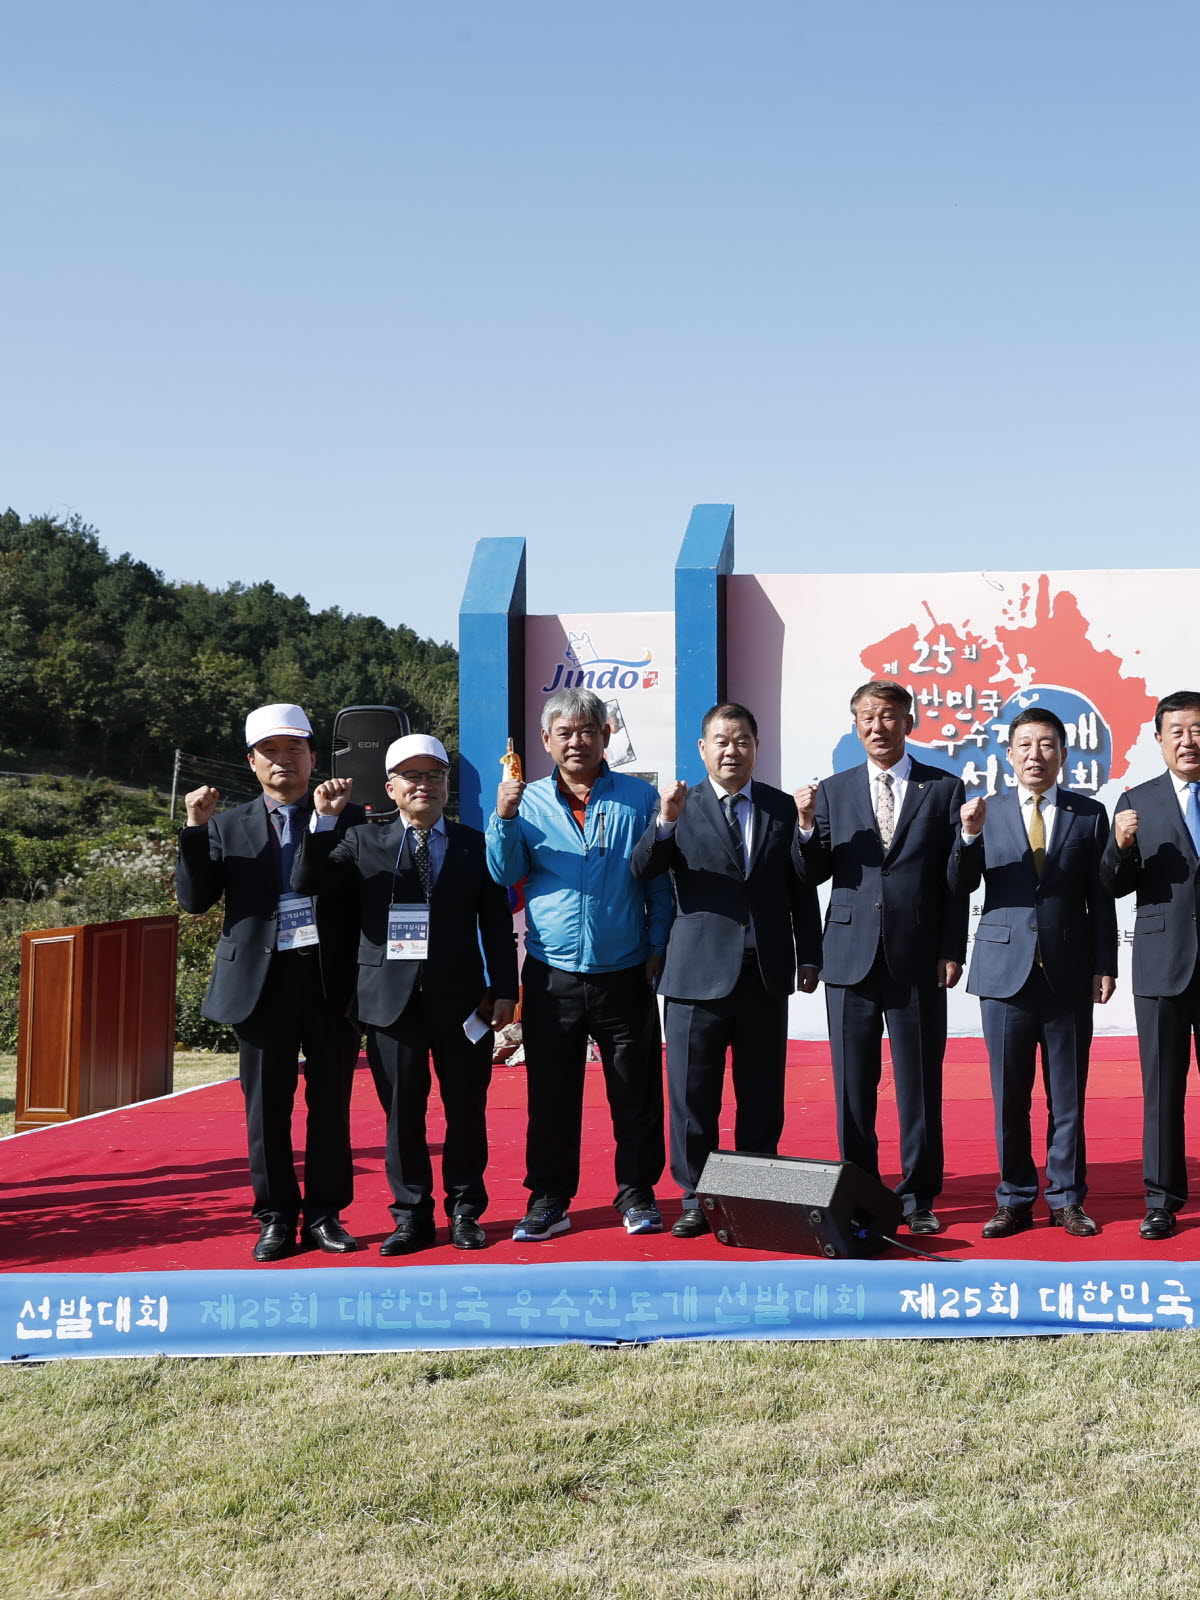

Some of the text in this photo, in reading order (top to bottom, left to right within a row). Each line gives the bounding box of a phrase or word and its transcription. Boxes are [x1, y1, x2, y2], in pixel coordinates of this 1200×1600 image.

[542, 664, 639, 692] Jindo
[278, 909, 311, 921] 도개심사원
[16, 1295, 168, 1340] 선발대회
[200, 1281, 865, 1331] 제25회 대한민국 우수진도개 선발대회
[900, 1281, 1019, 1320] 제25회
[1040, 1279, 1194, 1325] 대한민국
